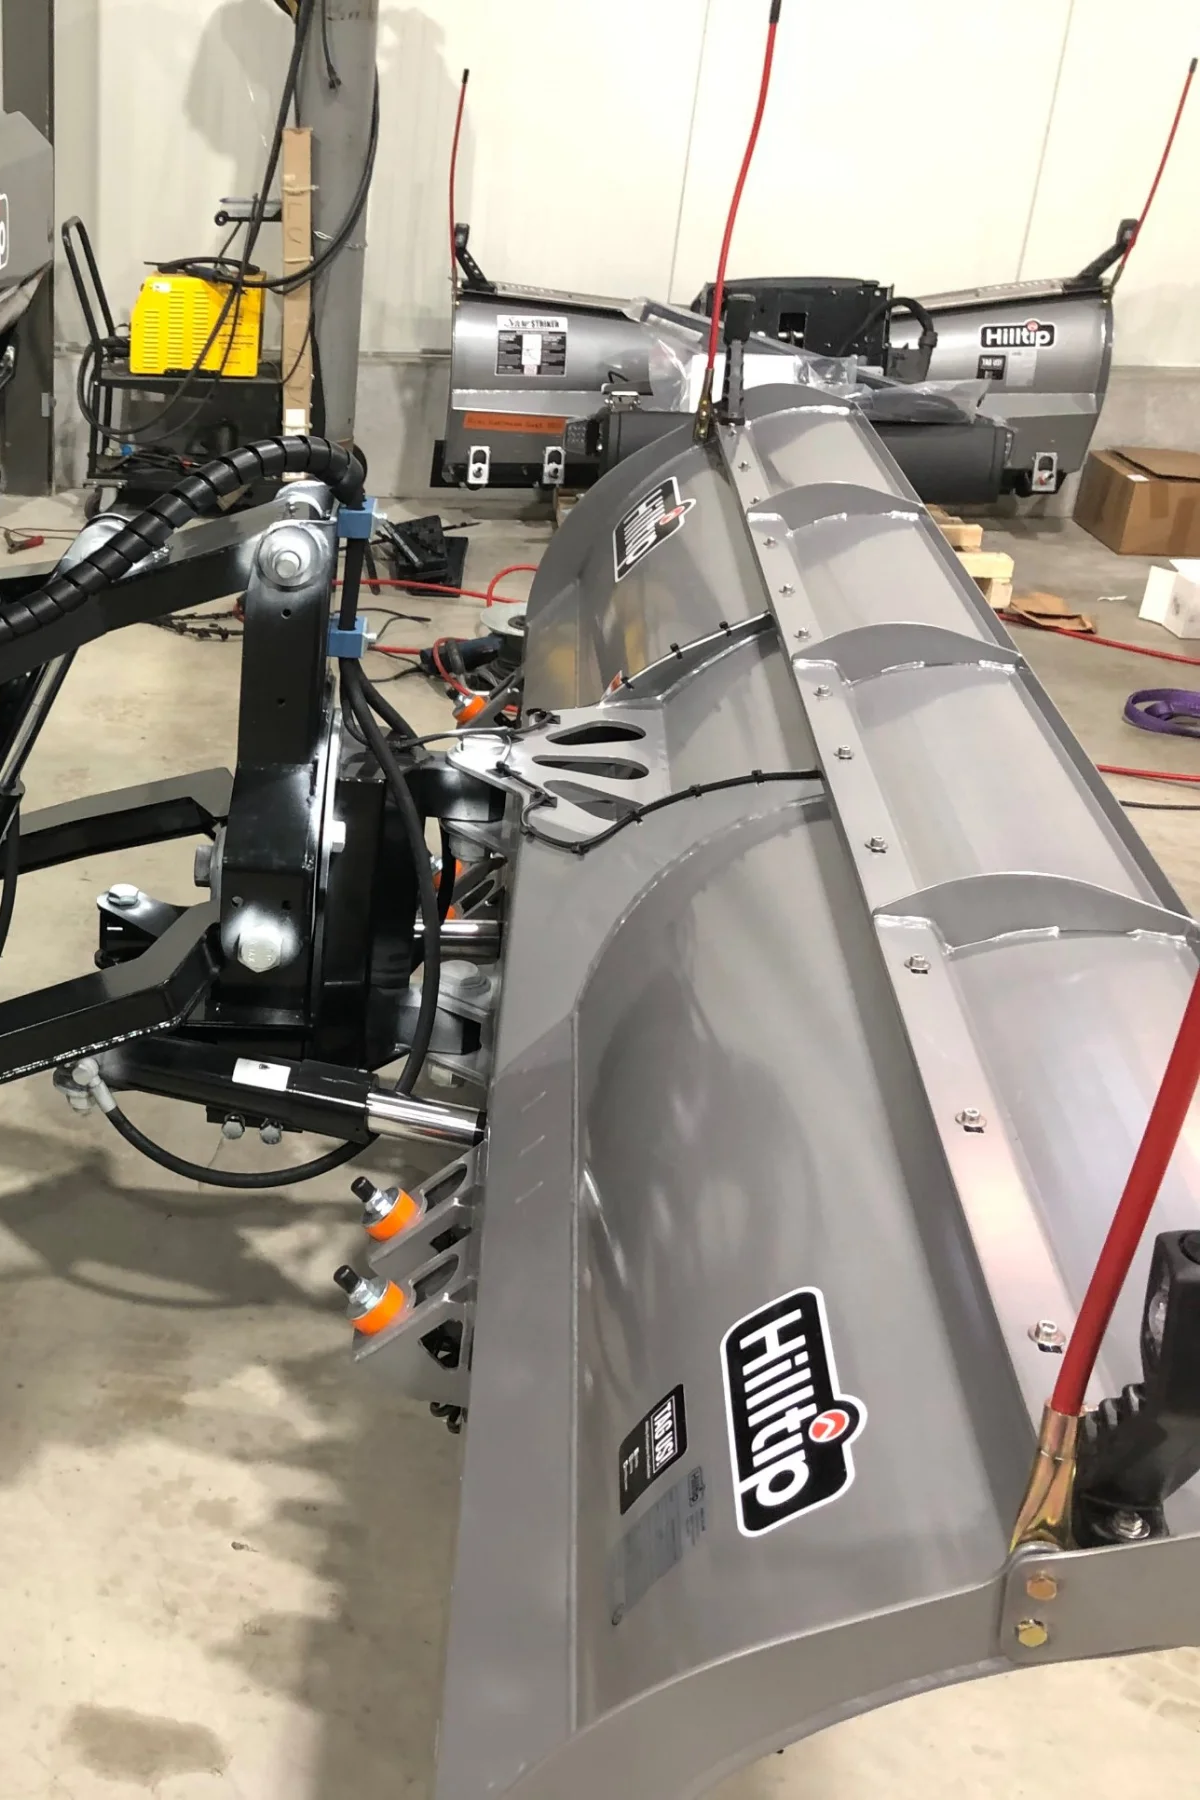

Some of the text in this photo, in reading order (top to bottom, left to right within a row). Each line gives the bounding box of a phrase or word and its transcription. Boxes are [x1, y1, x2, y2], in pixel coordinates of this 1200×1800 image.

[985, 327, 1051, 348] Hilltip
[617, 488, 664, 566] Hilltip
[654, 1401, 673, 1440] TAG
[738, 1308, 818, 1507] Hilltip
